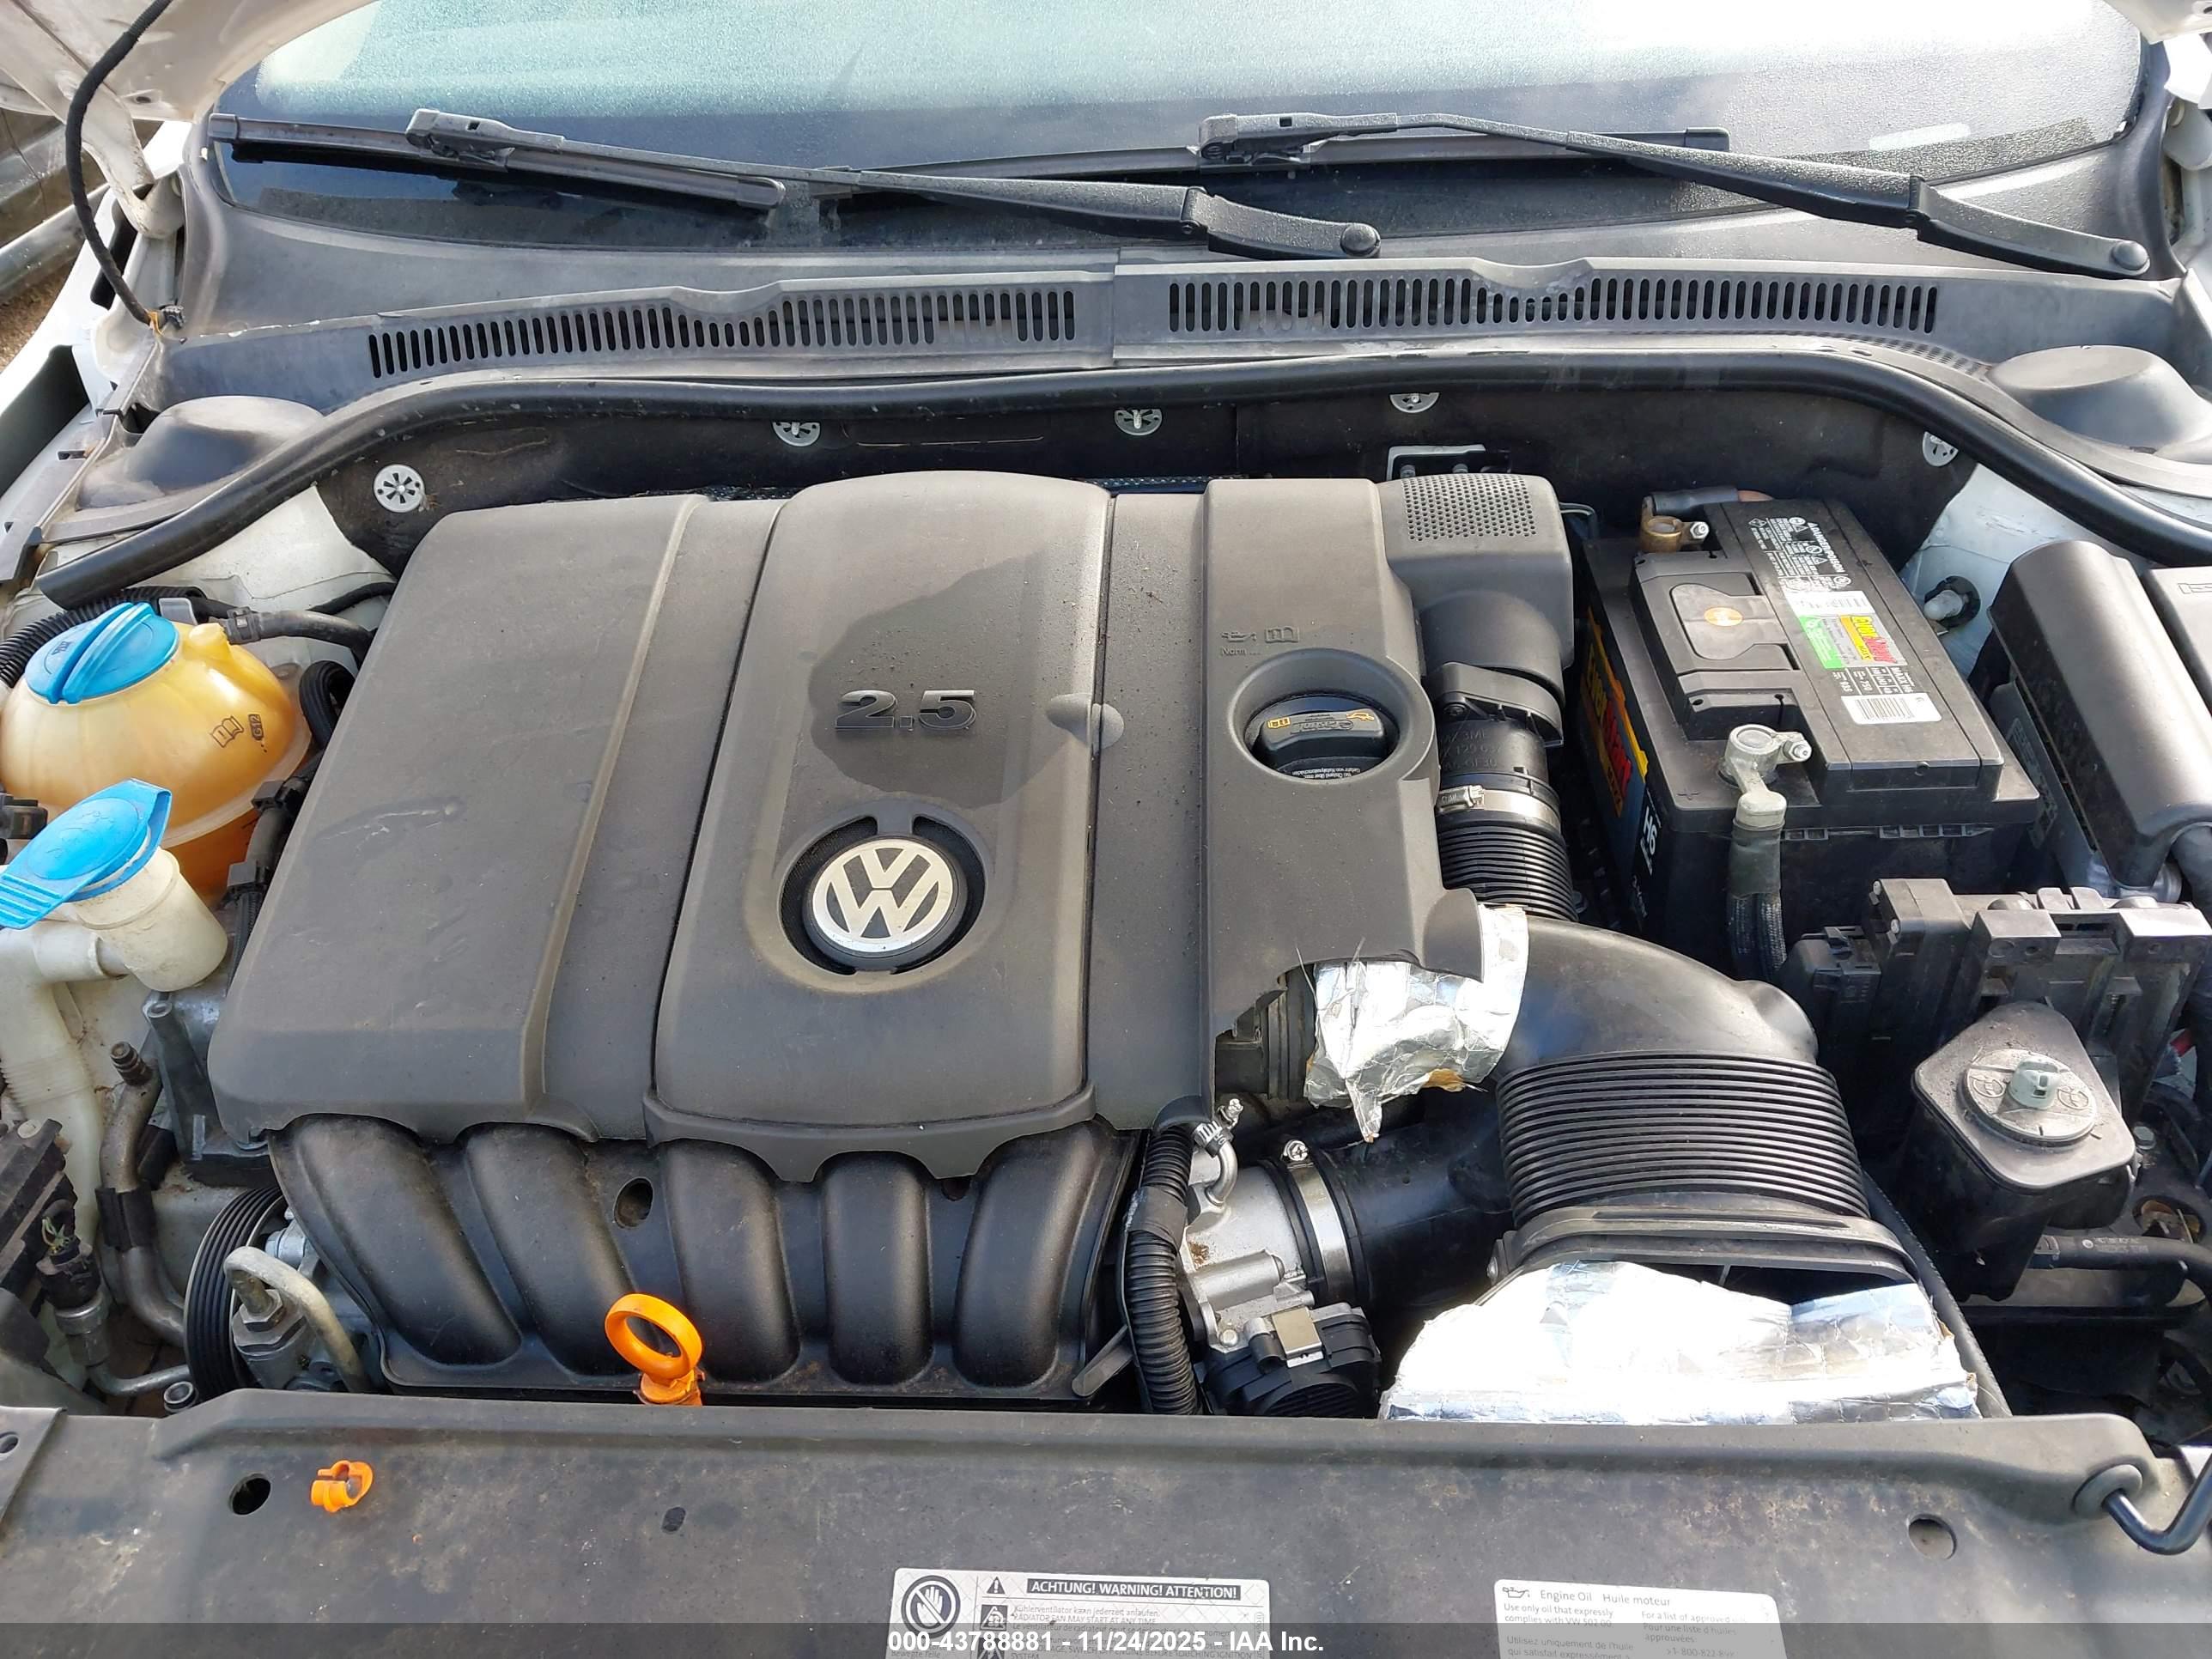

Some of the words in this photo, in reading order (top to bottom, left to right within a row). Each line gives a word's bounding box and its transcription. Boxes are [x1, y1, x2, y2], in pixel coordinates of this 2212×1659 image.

[836, 690, 976, 731] 2.5
[1643, 807, 1658, 856] H6
[1031, 1581, 1096, 1594] ACHTUNG!
[1099, 1583, 1163, 1596] WARNING!
[1166, 1585, 1237, 1599] ATTENTION!
[1540, 1589, 1575, 1602] Engine
[1577, 1591, 1592, 1601] Oil
[1603, 1594, 1629, 1604] Huile
[1633, 1596, 1670, 1606] moteur
[1522, 1604, 1539, 1614] only
[1541, 1604, 1552, 1613] oil
[1554, 1605, 1571, 1614] that
[1574, 1607, 1613, 1619] expressly
[1642, 1611, 1654, 1620] For
[1664, 1612, 1676, 1620] list
[1023, 1622, 1061, 1632] ventilateur
[1504, 1614, 1542, 1624] complies
[1545, 1615, 1564, 1625] with
[1565, 1617, 1580, 1626] VW
[1643, 1623, 1663, 1632] Pour
[1683, 1625, 1701, 1633] liste
[1507, 1636, 1538, 1645] Utilisez
[1541, 1638, 1593, 1649] uniquement
[1595, 1641, 1606, 1650] de
[1508, 1648, 1521, 1656] qui
[1524, 1648, 1558, 1658] satisfait
